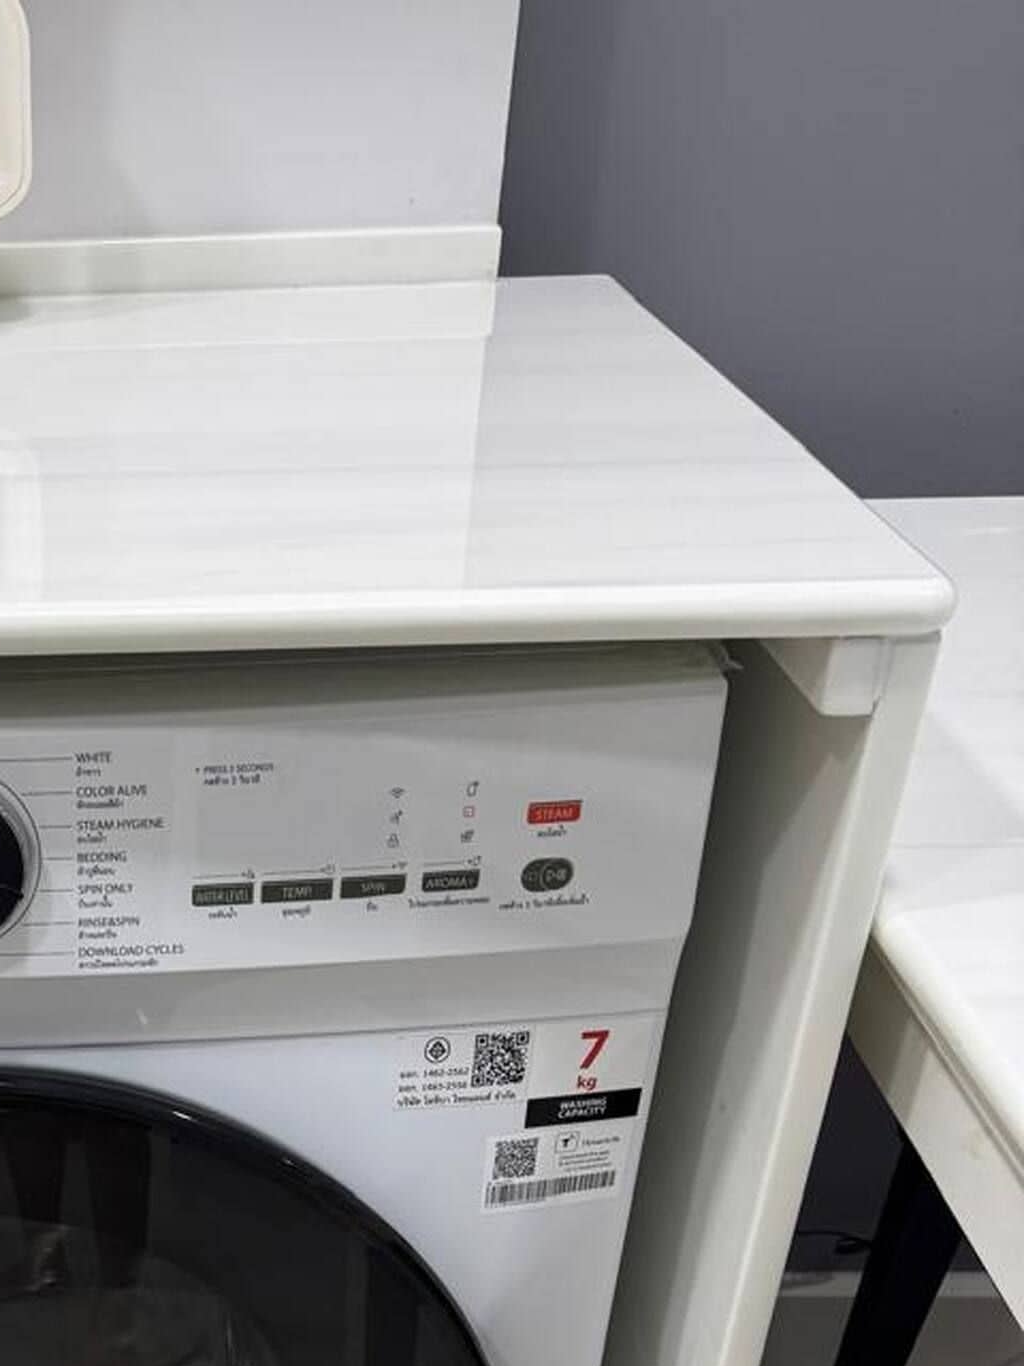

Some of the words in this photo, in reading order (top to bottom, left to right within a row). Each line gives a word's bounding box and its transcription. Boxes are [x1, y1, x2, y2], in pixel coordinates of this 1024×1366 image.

[76, 751, 112, 763] WHITE
[76, 786, 116, 798] COLOR
[117, 784, 148, 796] ALIVE
[534, 806, 575, 820] STEAM
[77, 819, 115, 831] STEAM
[117, 816, 164, 829] HYGIENE
[77, 852, 128, 863] BEDDING
[78, 884, 103, 895] SPIN
[105, 882, 133, 894] ONLY
[78, 917, 140, 929] RINSE&SPIN
[78, 945, 144, 959] DOWNLOAD
[145, 944, 185, 956] CYCLES
[581, 1029, 611, 1070] 7
[577, 1075, 598, 1091] kg
[559, 1096, 608, 1110] WASHING
[558, 1106, 607, 1119] CAPACITY
